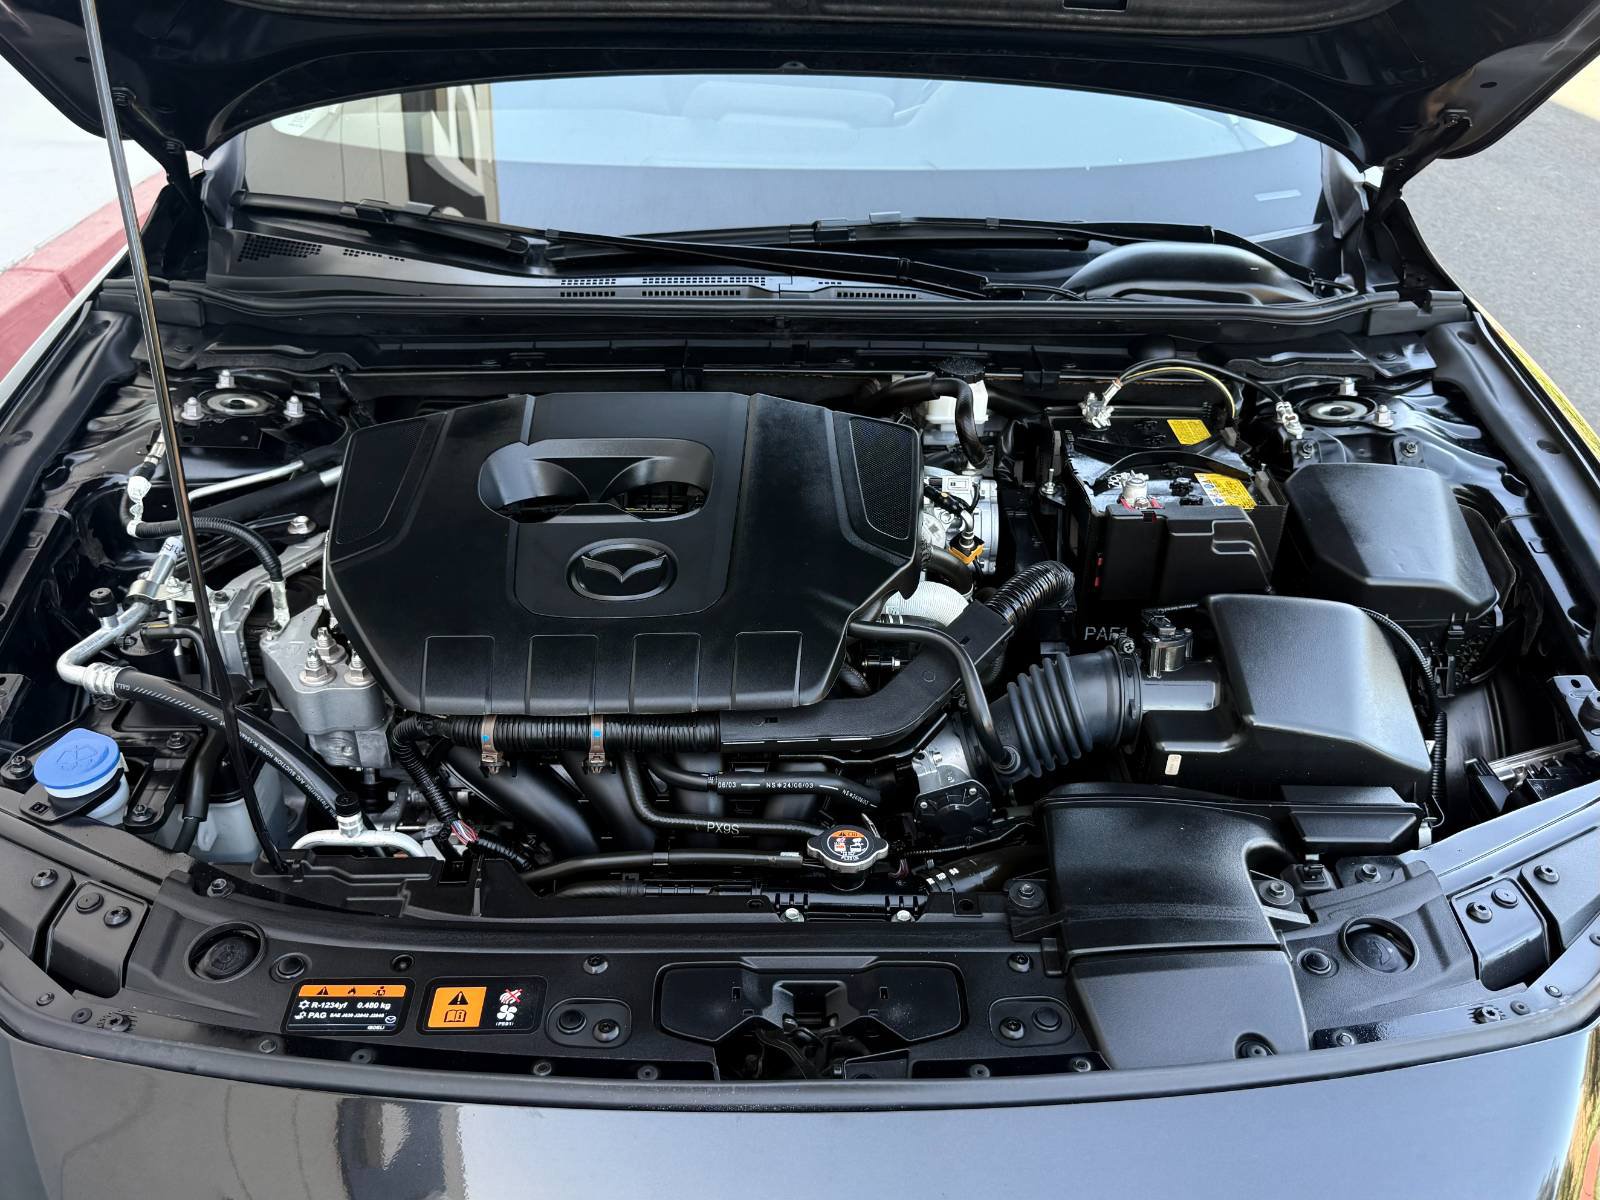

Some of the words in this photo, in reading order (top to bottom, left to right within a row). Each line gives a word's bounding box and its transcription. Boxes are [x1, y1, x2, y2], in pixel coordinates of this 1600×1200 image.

[259, 745, 274, 758] HOSE
[273, 756, 297, 777] SUCTION
[706, 821, 740, 835] PX9S
[310, 1001, 348, 1010] R-1234yf
[380, 1001, 391, 1010] kg
[307, 1011, 327, 1019] PAG
